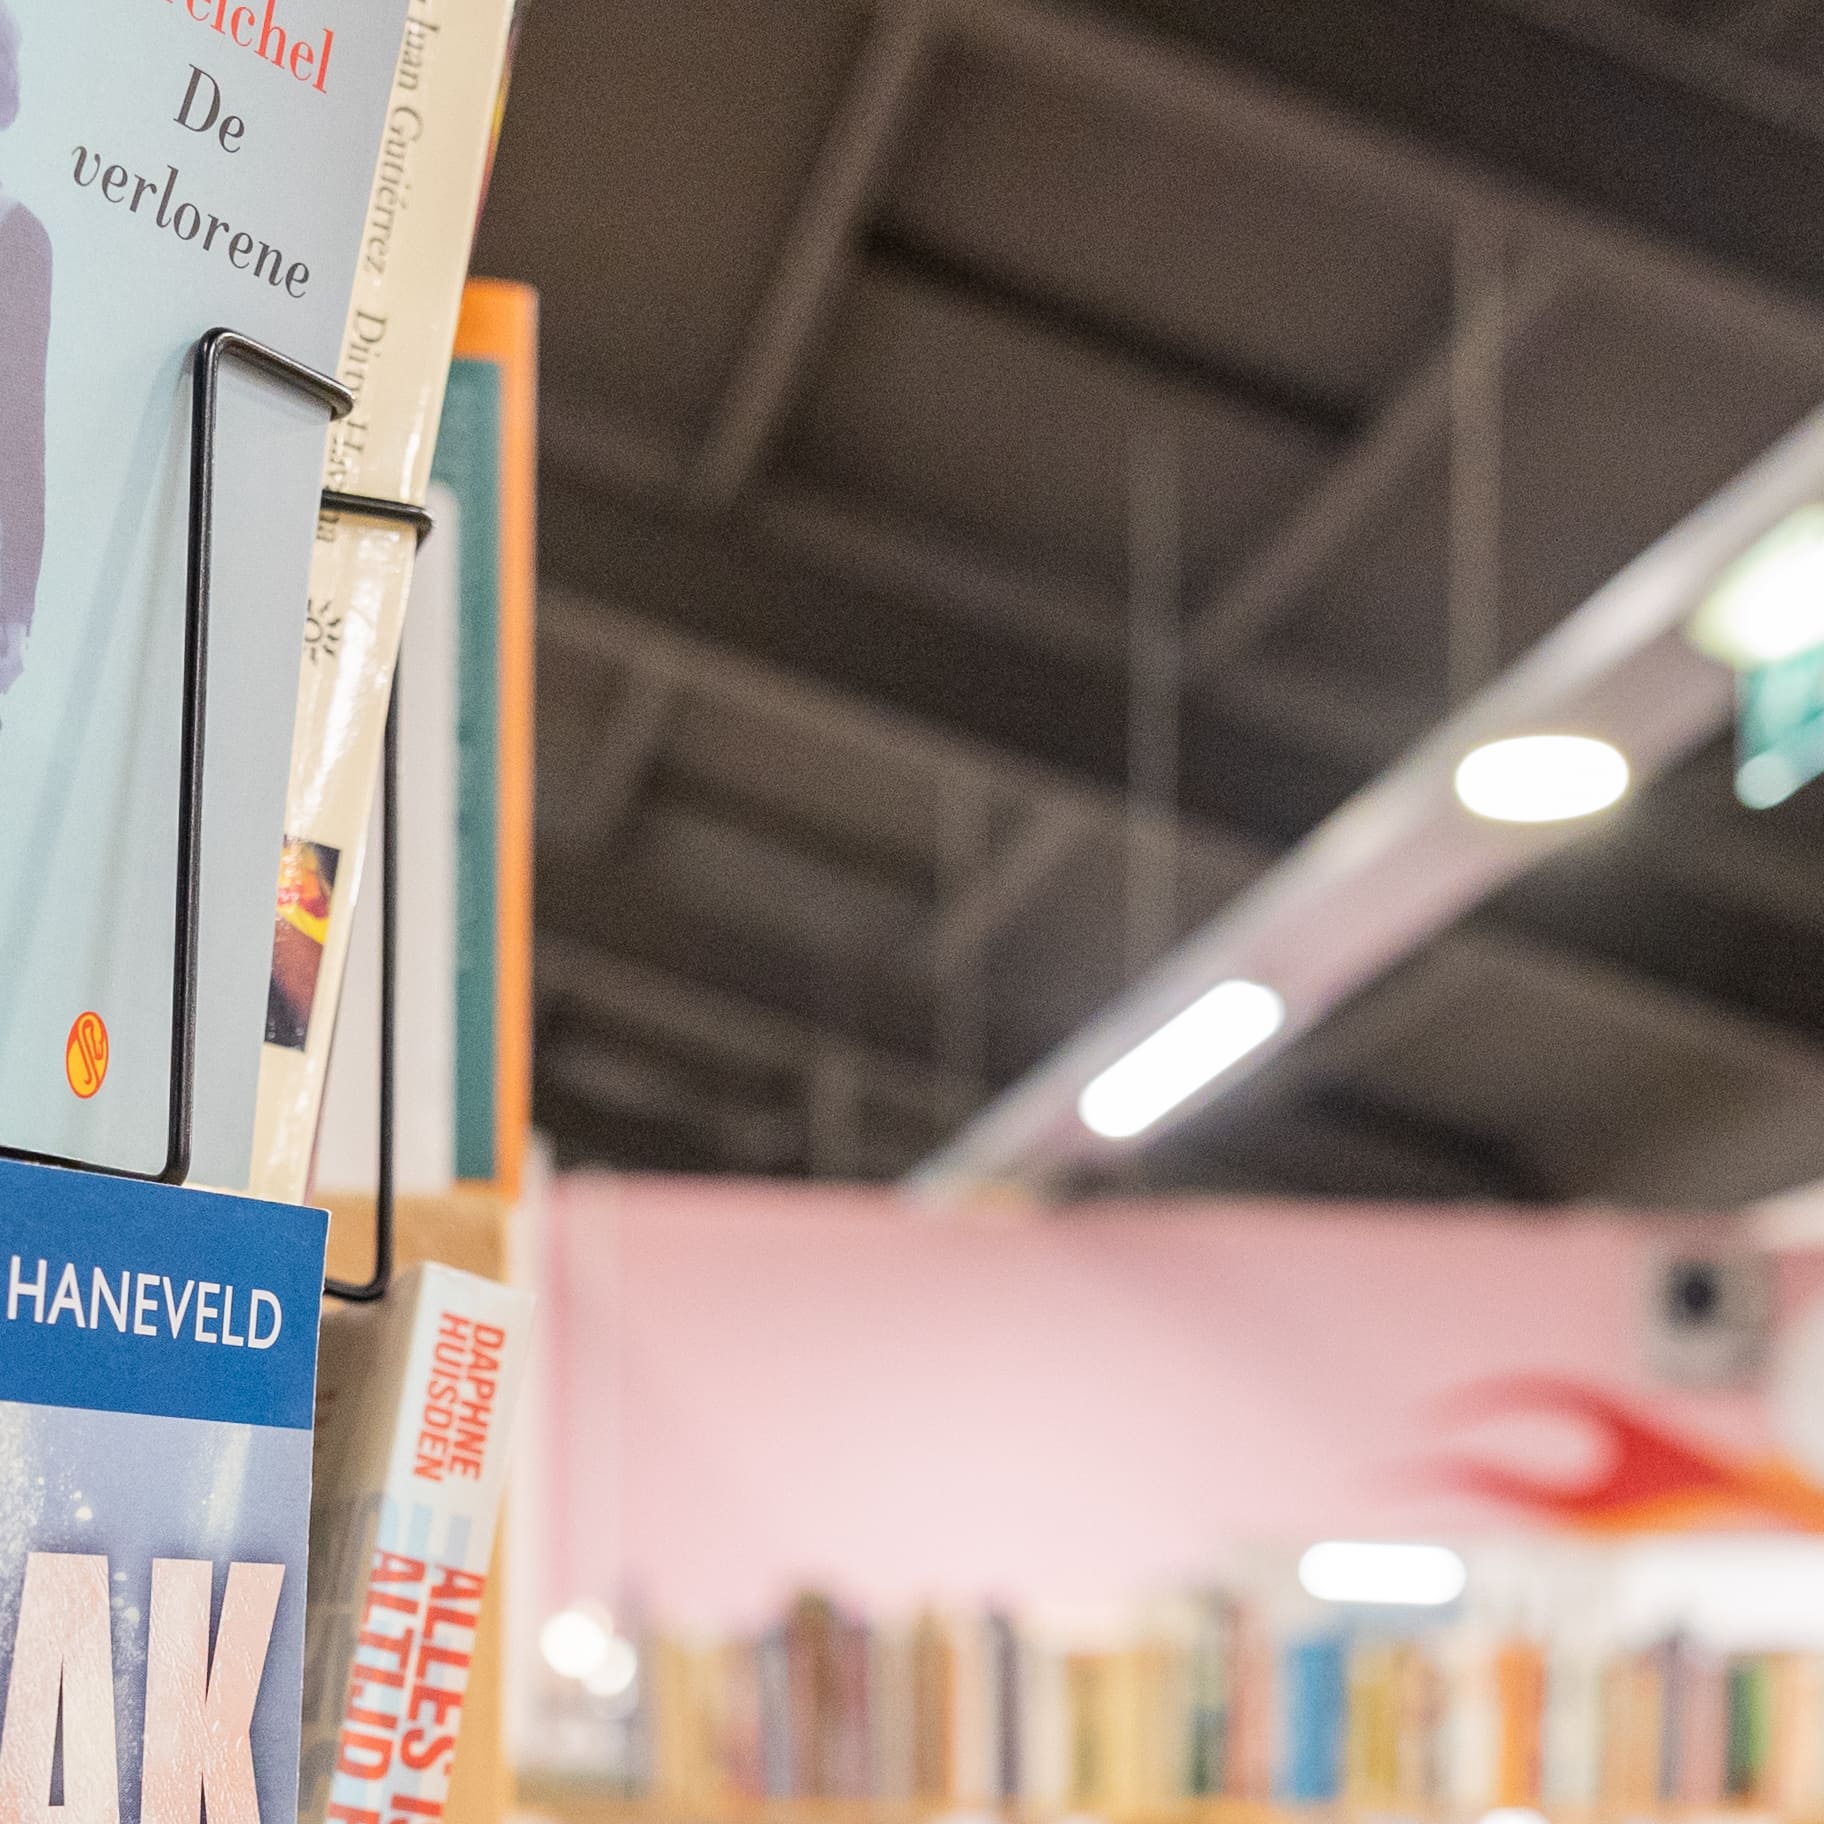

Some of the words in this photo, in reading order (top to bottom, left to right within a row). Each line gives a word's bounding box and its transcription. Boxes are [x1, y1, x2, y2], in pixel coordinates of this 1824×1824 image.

[173, 63, 245, 154] De
[71, 142, 311, 299] verlorene
[7, 1255, 283, 1351] HANEVELD
[412, 1311, 471, 1483] HUISDEN
[447, 1320, 506, 1482] DAPHNE
[335, 1547, 426, 1785] ALTIJD
[398, 1562, 487, 1772] ALLES
